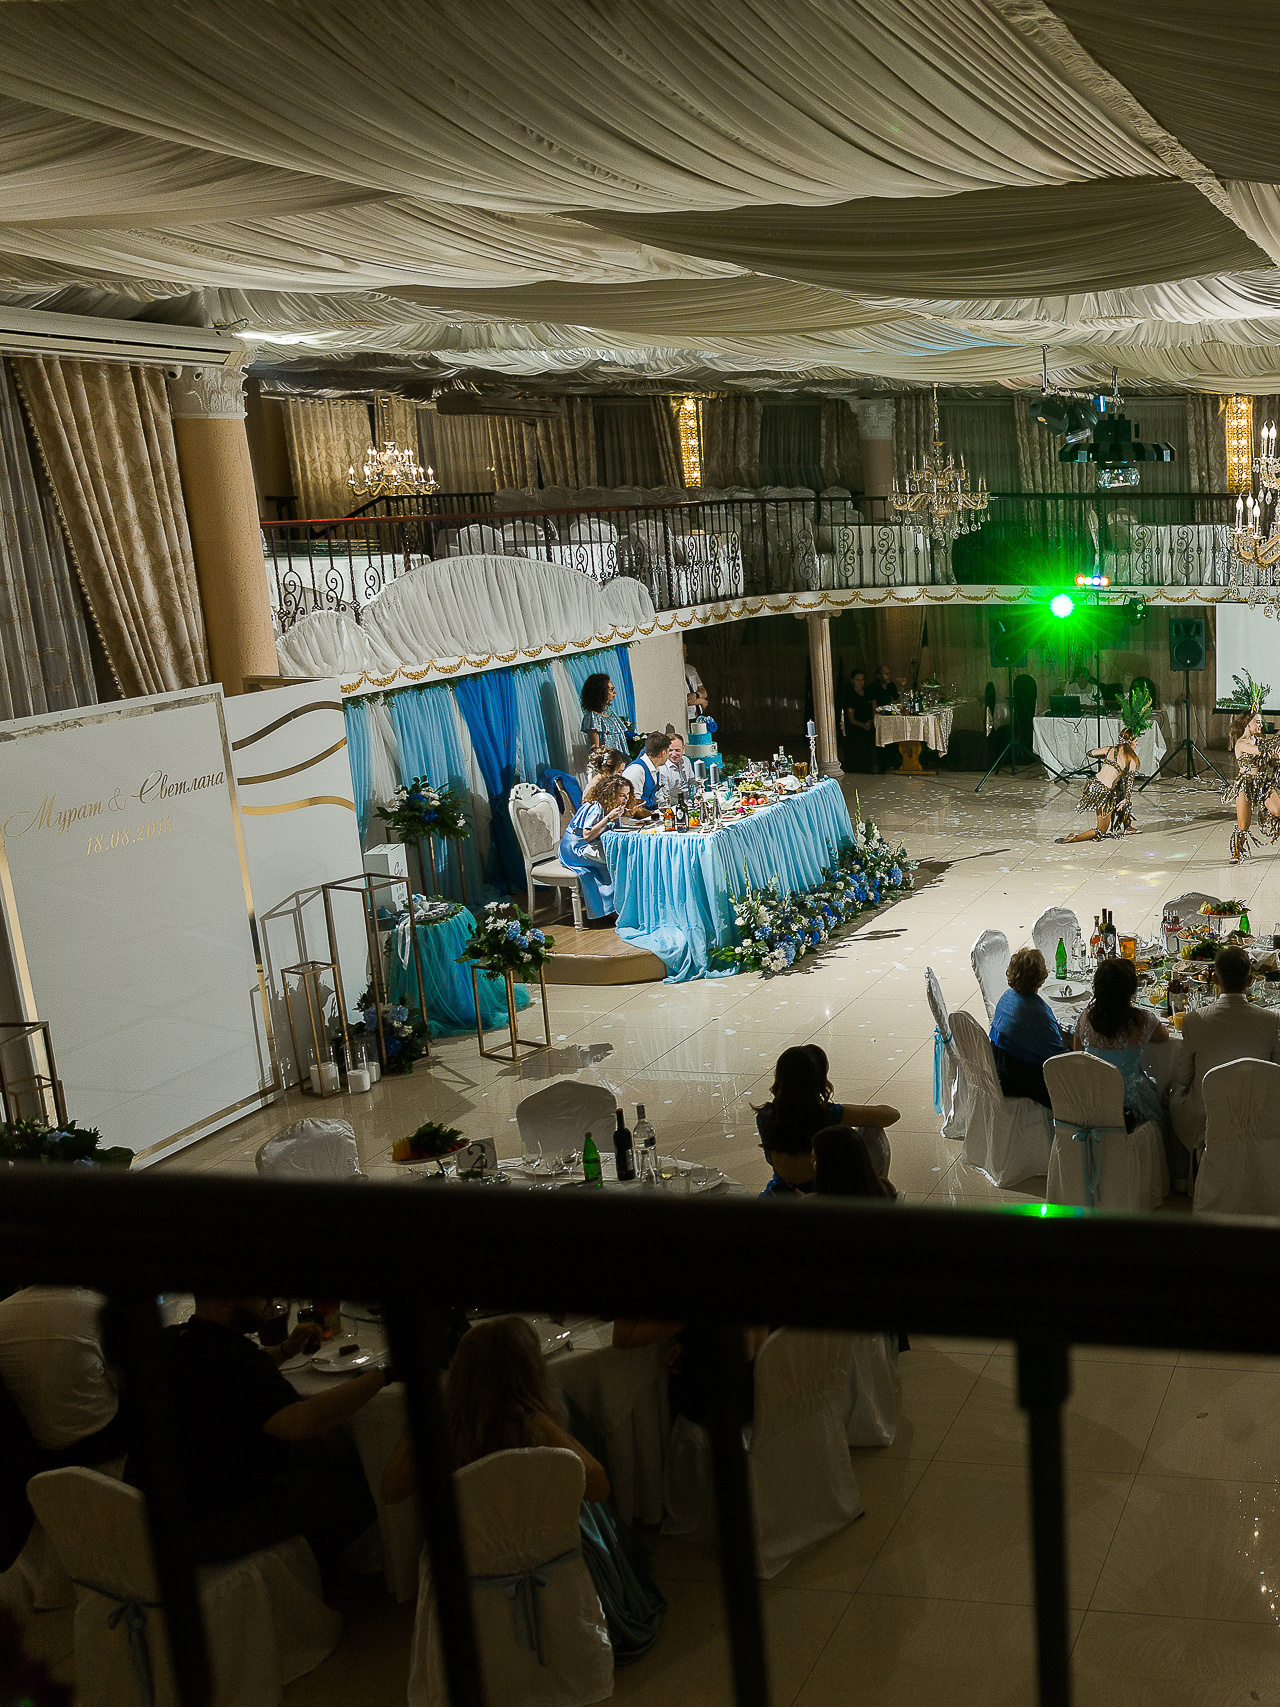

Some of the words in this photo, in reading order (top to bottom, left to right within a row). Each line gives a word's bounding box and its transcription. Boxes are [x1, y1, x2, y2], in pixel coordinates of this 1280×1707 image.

[2, 793, 104, 838] Мурат
[107, 787, 127, 812] &
[131, 769, 225, 804] Светлана
[86, 815, 173, 856] 18.08.2018
[467, 1143, 488, 1169] 2
